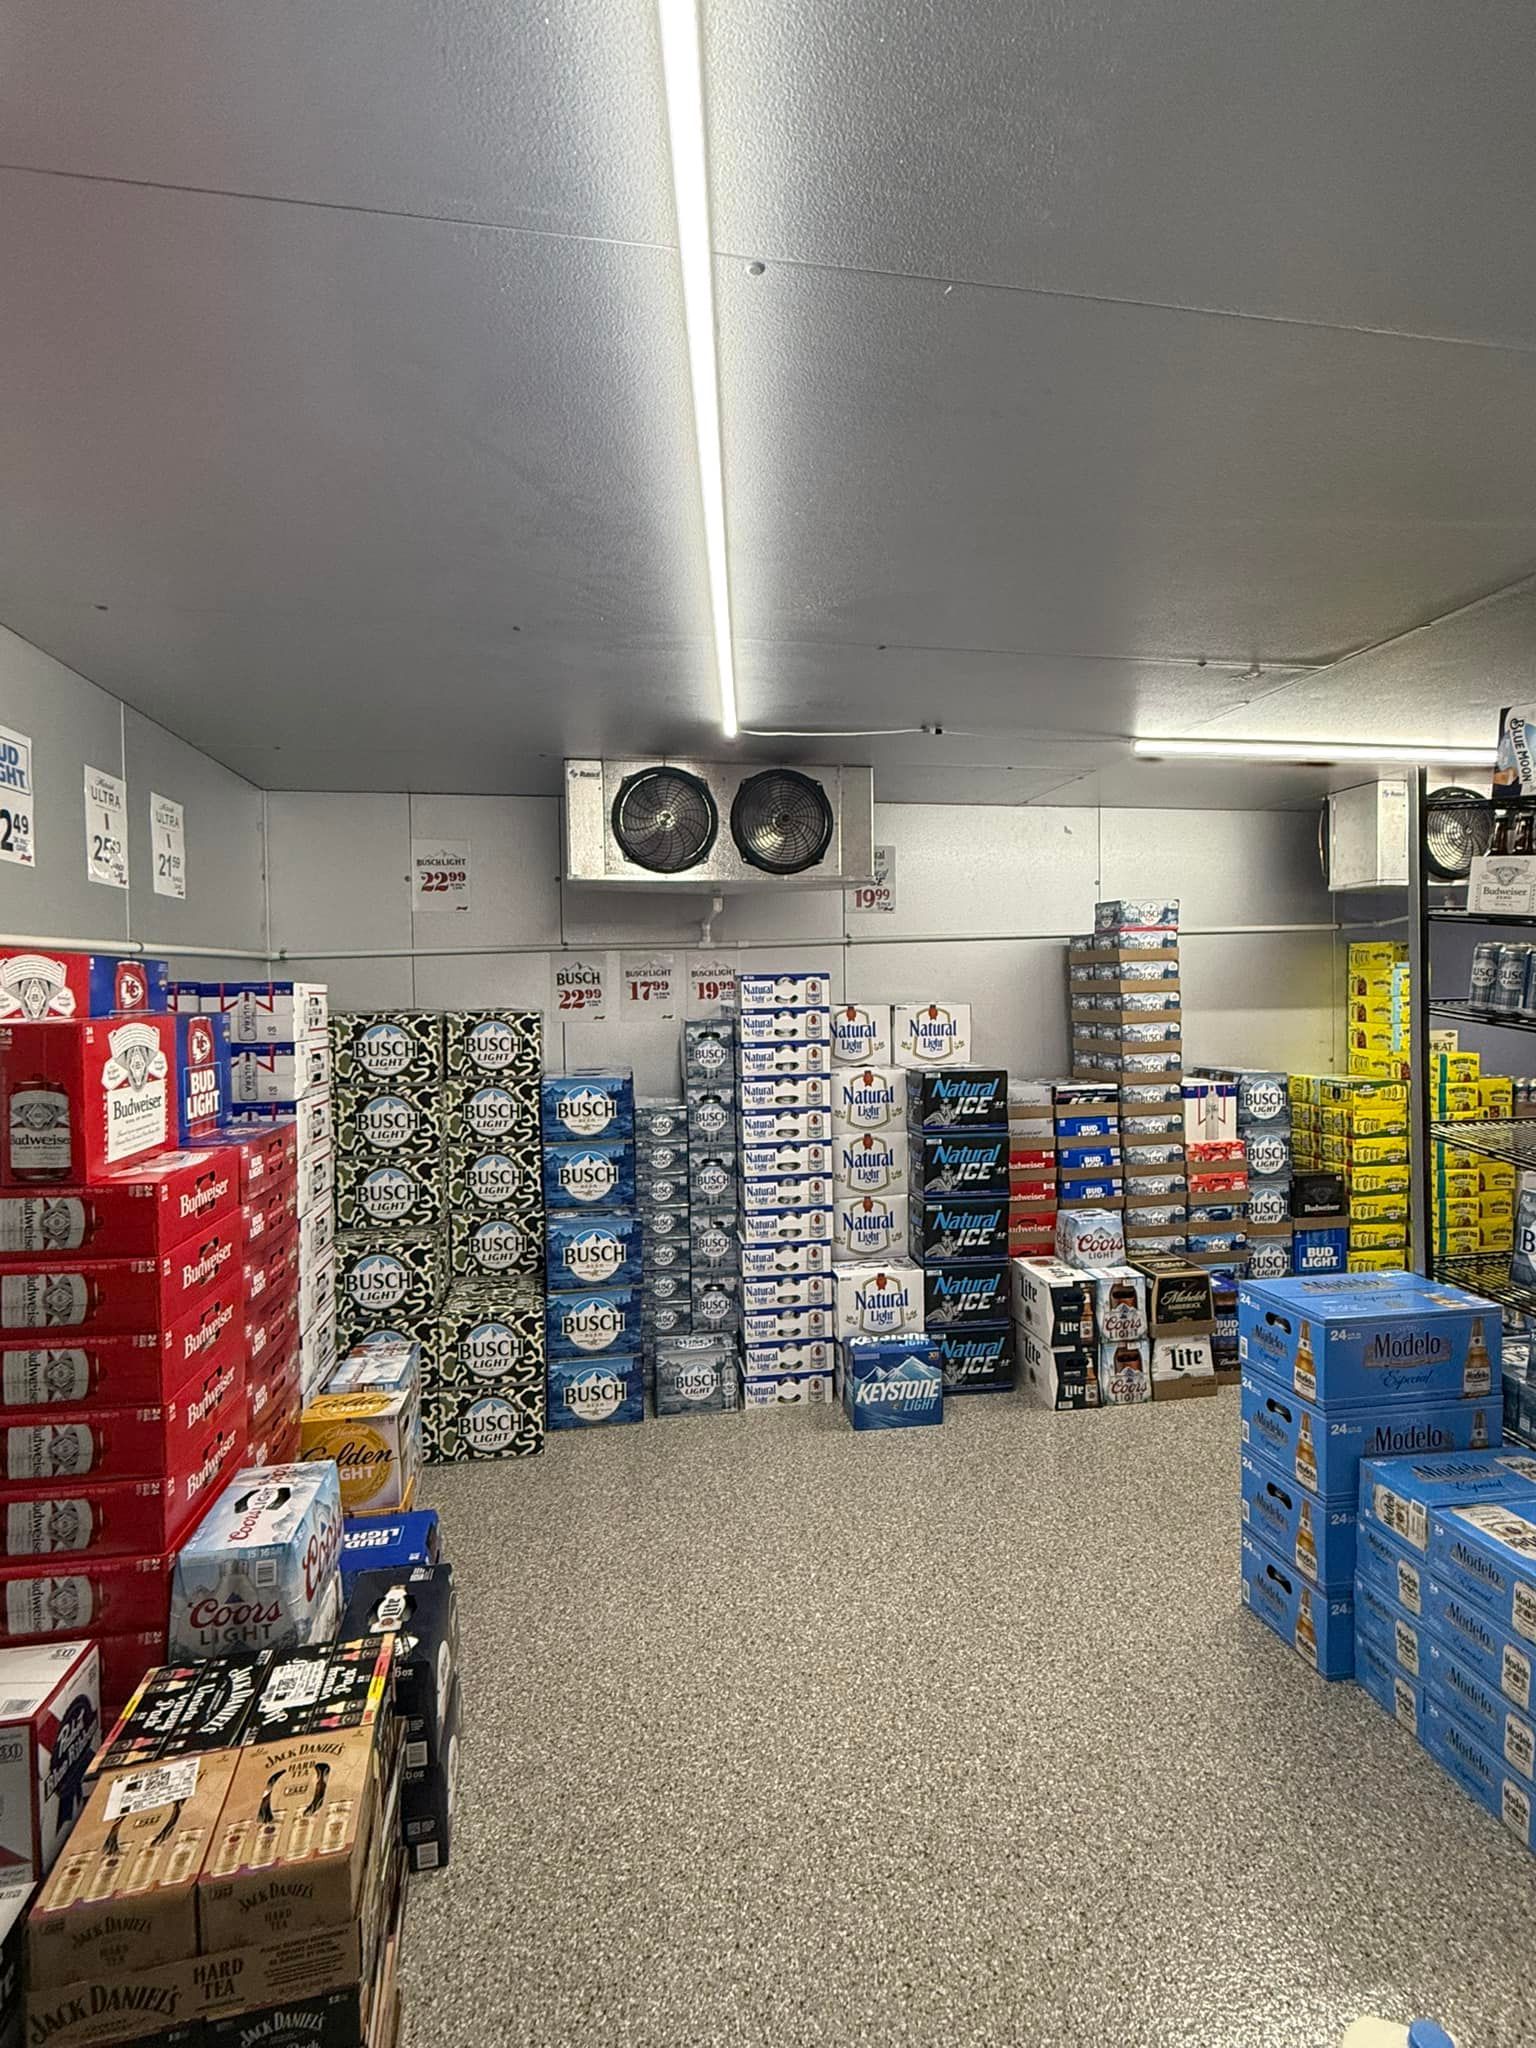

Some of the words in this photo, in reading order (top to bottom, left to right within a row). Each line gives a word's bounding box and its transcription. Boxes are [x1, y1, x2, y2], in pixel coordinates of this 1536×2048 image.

[1509, 718, 1525, 753] BLUE
[1517, 751, 1532, 783] MOON
[91, 786, 121, 809] ULTRA
[156, 811, 179, 829] ULTRA
[1482, 886, 1528, 896] Budweiser
[556, 972, 601, 986] BUSCH
[648, 969, 671, 977] LIGHT
[743, 983, 773, 994] Natural
[743, 1017, 773, 1028] Natural
[830, 1022, 876, 1039] Natural
[910, 1019, 957, 1037] Natural
[355, 1041, 417, 1058] BUSCH
[465, 1036, 521, 1052] BUSCH
[841, 1038, 864, 1054] Light
[922, 1037, 944, 1052] Light
[368, 1058, 403, 1067] LIGHT
[477, 1052, 509, 1061] LIGHT
[743, 1051, 774, 1062] Natural
[190, 1068, 215, 1093] BUD
[931, 1078, 1000, 1099] Natural
[744, 1085, 774, 1096] Natural
[843, 1086, 894, 1104] Natural
[112, 1093, 162, 1121] Budweiser
[186, 1090, 221, 1120] LIGHT
[464, 1104, 520, 1120] BUSCH
[558, 1102, 616, 1118] BUSCH
[857, 1104, 881, 1120] Light
[953, 1096, 990, 1115] ICE
[357, 1113, 418, 1131] BUSCH
[476, 1120, 509, 1129] LIGHT
[745, 1118, 775, 1129] Natural
[1080, 1124, 1099, 1132] BUD
[370, 1130, 406, 1139] LIGHT
[843, 1149, 894, 1169] Natural
[932, 1144, 1001, 1164] Natural
[466, 1171, 522, 1187] BUSCH
[559, 1167, 618, 1184] BUSCH
[857, 1167, 879, 1184] Light
[956, 1162, 994, 1181] ICE
[180, 1179, 229, 1218] Budweiser
[357, 1184, 419, 1202] BUSCH
[478, 1186, 511, 1195] LIGHT
[370, 1202, 406, 1211] LIGHT
[843, 1212, 894, 1231] Natural
[932, 1209, 1000, 1231] Natural
[469, 1236, 526, 1253] BUSCH
[857, 1230, 881, 1245] Light
[956, 1227, 994, 1246] ICE
[1077, 1233, 1123, 1252] Coors
[481, 1253, 514, 1262] LIGHT
[564, 1247, 625, 1265] BUSCH
[1088, 1251, 1114, 1260] LIGHT
[1307, 1247, 1334, 1258] BUD
[182, 1242, 233, 1290] Budweiser
[1302, 1256, 1339, 1268] LIGHT
[346, 1272, 411, 1292] BUSCH
[932, 1274, 1000, 1295] Natural
[1020, 1277, 1038, 1304] Lite
[360, 1291, 398, 1300] LIGHT
[855, 1288, 909, 1310] Natural
[957, 1292, 995, 1311] ICE
[1239, 1293, 1252, 1306] 24
[563, 1314, 625, 1334] BUSCH
[870, 1309, 894, 1325] Light
[1104, 1317, 1141, 1331] Coors
[1216, 1319, 1240, 1329] BUD
[184, 1304, 234, 1360] Budweiser
[1059, 1322, 1079, 1335] Lite
[1330, 1329, 1348, 1342] 24
[459, 1340, 523, 1360] BUSCH
[940, 1337, 1006, 1358] Natural
[1023, 1337, 1041, 1366] Lite
[1374, 1331, 1441, 1359] Modelo
[472, 1359, 509, 1368] LIGHT
[961, 1355, 997, 1374] ICE
[1169, 1348, 1204, 1371] Lite
[1110, 1381, 1147, 1394] Coors
[1242, 1377, 1254, 1390] 24
[1382, 1369, 1434, 1388] Especial
[187, 1366, 236, 1429] Budweiser
[564, 1383, 626, 1404] BUSCH
[855, 1379, 942, 1404] KEYSTONE
[1064, 1385, 1084, 1398] Lite
[903, 1399, 937, 1411] LIGHT
[459, 1414, 523, 1434] BUSCH
[1330, 1423, 1348, 1435] 24
[472, 1433, 510, 1443] LIGHT
[1375, 1425, 1443, 1451] Modelo
[187, 1430, 236, 1500] Budweiser
[340, 1465, 376, 1480] GHT
[1241, 1457, 1253, 1470] 24
[1413, 1463, 1491, 1478] Modelo
[228, 1511, 259, 1543] Coors
[1330, 1513, 1348, 1525] 24
[345, 1536, 390, 1549] BUD
[1242, 1538, 1253, 1550] 24
[1454, 1543, 1500, 1584] Modelo
[189, 1598, 283, 1629] Coors
[1330, 1603, 1348, 1616] 24
[1449, 1601, 1490, 1646] Modelo
[200, 1623, 273, 1646] LIGHT
[1450, 1666, 1492, 1714] Modelo
[265, 1750, 297, 1768] JACK
[299, 1743, 346, 1757] DANIEL'S
[1450, 1727, 1490, 1777] Modelo
[193, 1957, 244, 1984] HARD
[202, 1979, 236, 2000] TEA
[30, 1997, 88, 2044] JACK
[89, 1985, 184, 2016] DANIEL'S
[240, 2020, 274, 2047] JACK
[273, 2011, 326, 2031] DANIEL'S
